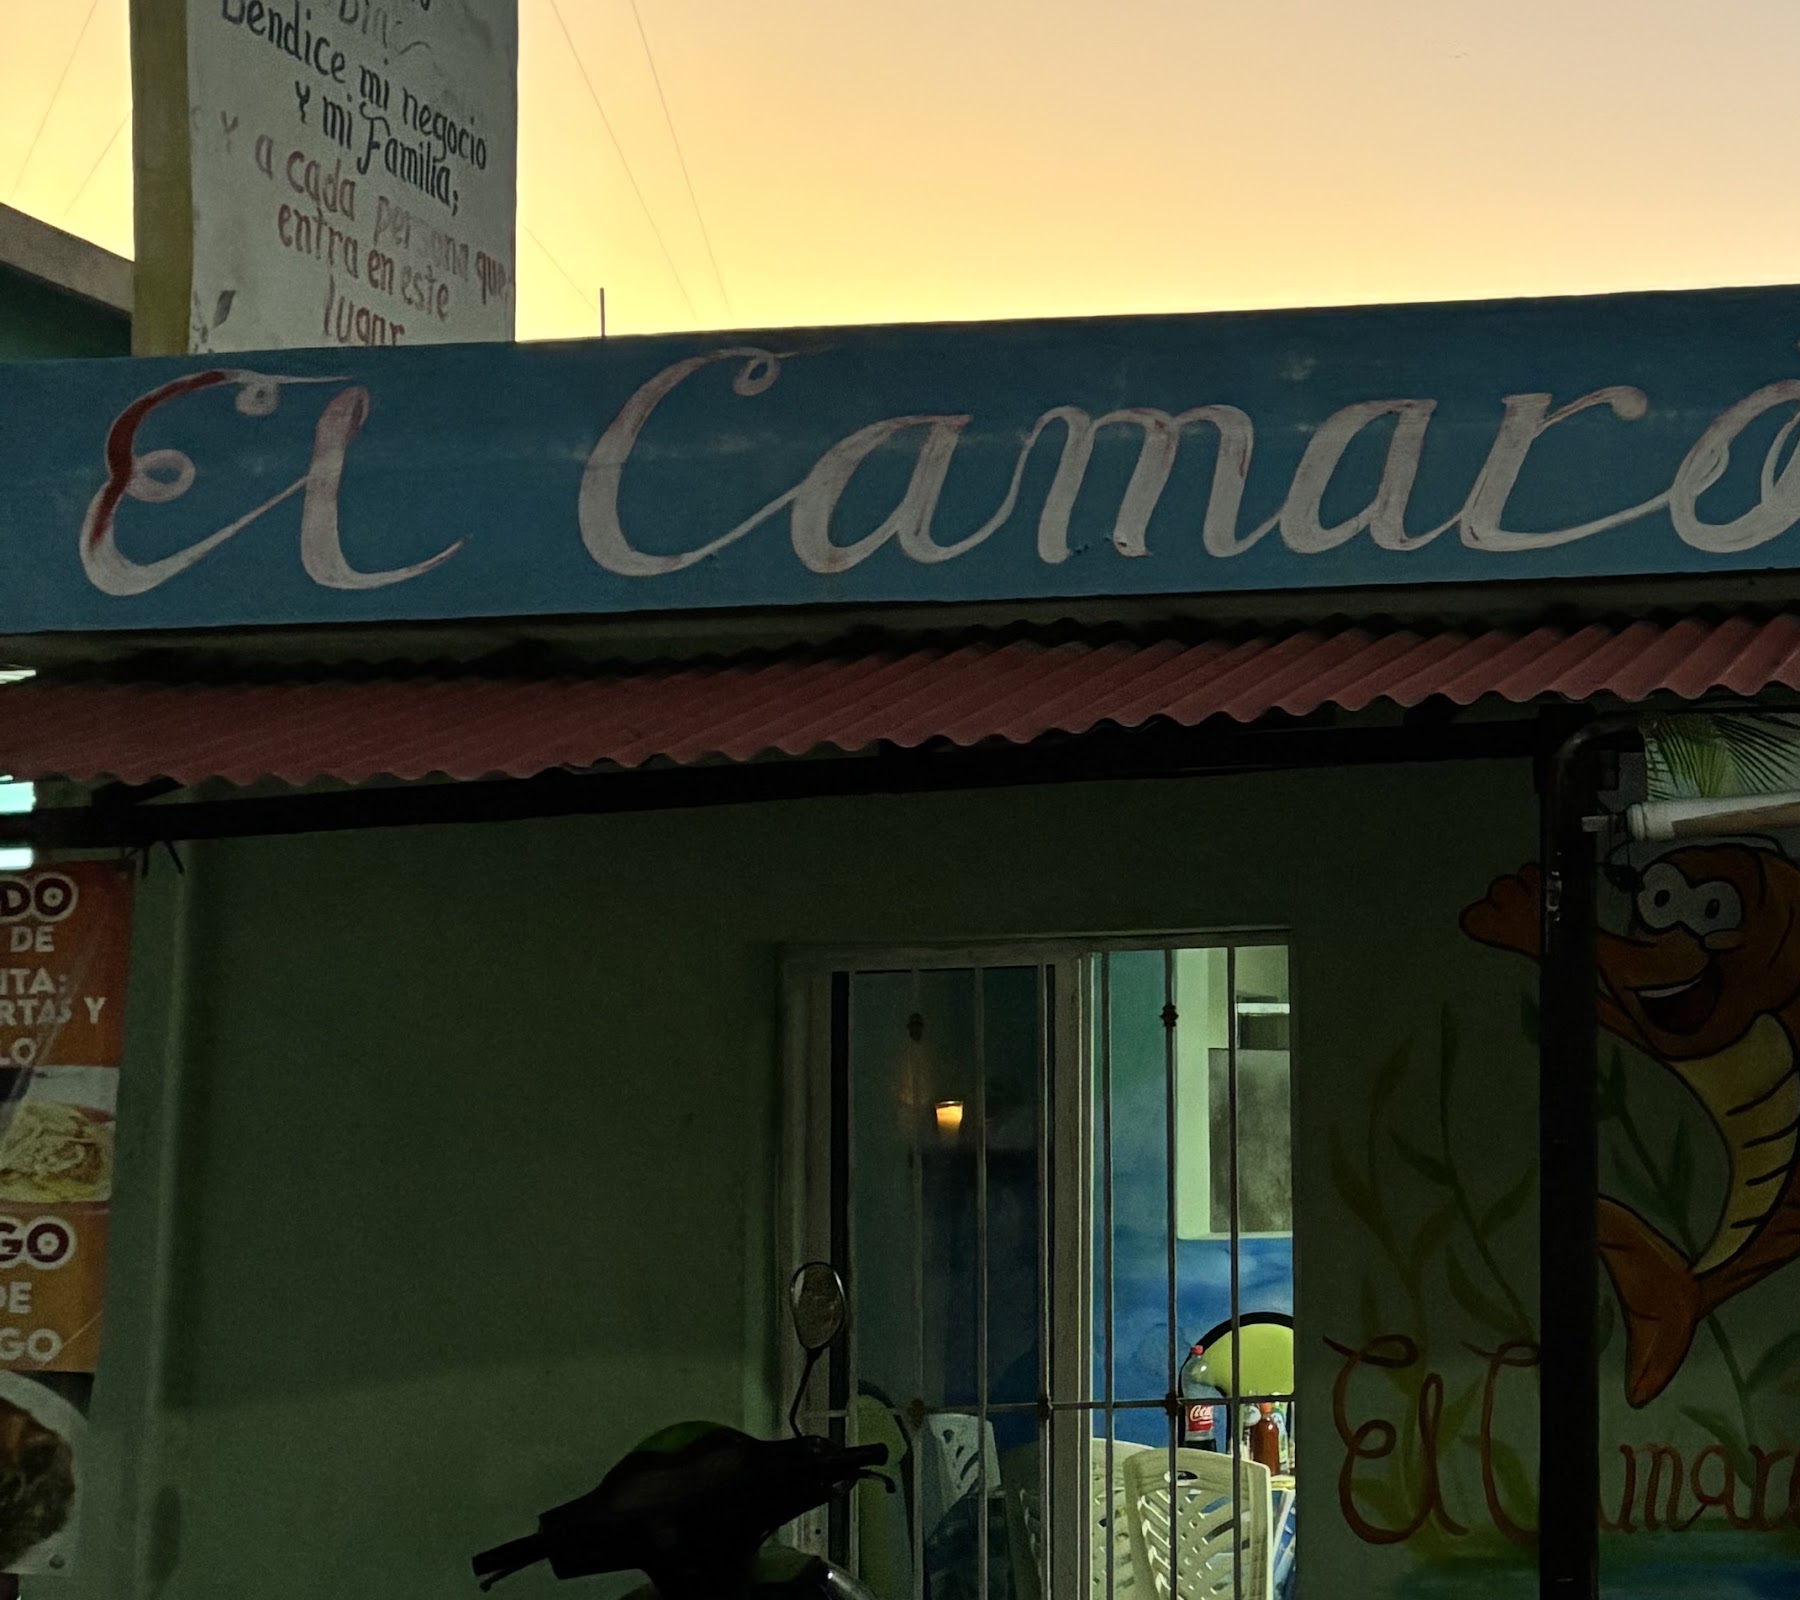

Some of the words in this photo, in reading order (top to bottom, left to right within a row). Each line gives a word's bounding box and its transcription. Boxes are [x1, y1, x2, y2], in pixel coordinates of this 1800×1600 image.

[322, 93, 352, 150] mi
[359, 57, 390, 112] mi
[402, 86, 487, 170] negocio
[255, 133, 274, 180] a
[286, 150, 356, 222] cada
[373, 194, 470, 282] perona
[277, 203, 360, 280] entra
[367, 248, 395, 296] en
[401, 264, 450, 322] este
[78, 368, 471, 596] El
[10, 925, 55, 953] DE
[83, 997, 107, 1025] Y
[1321, 1333, 1470, 1546] El
